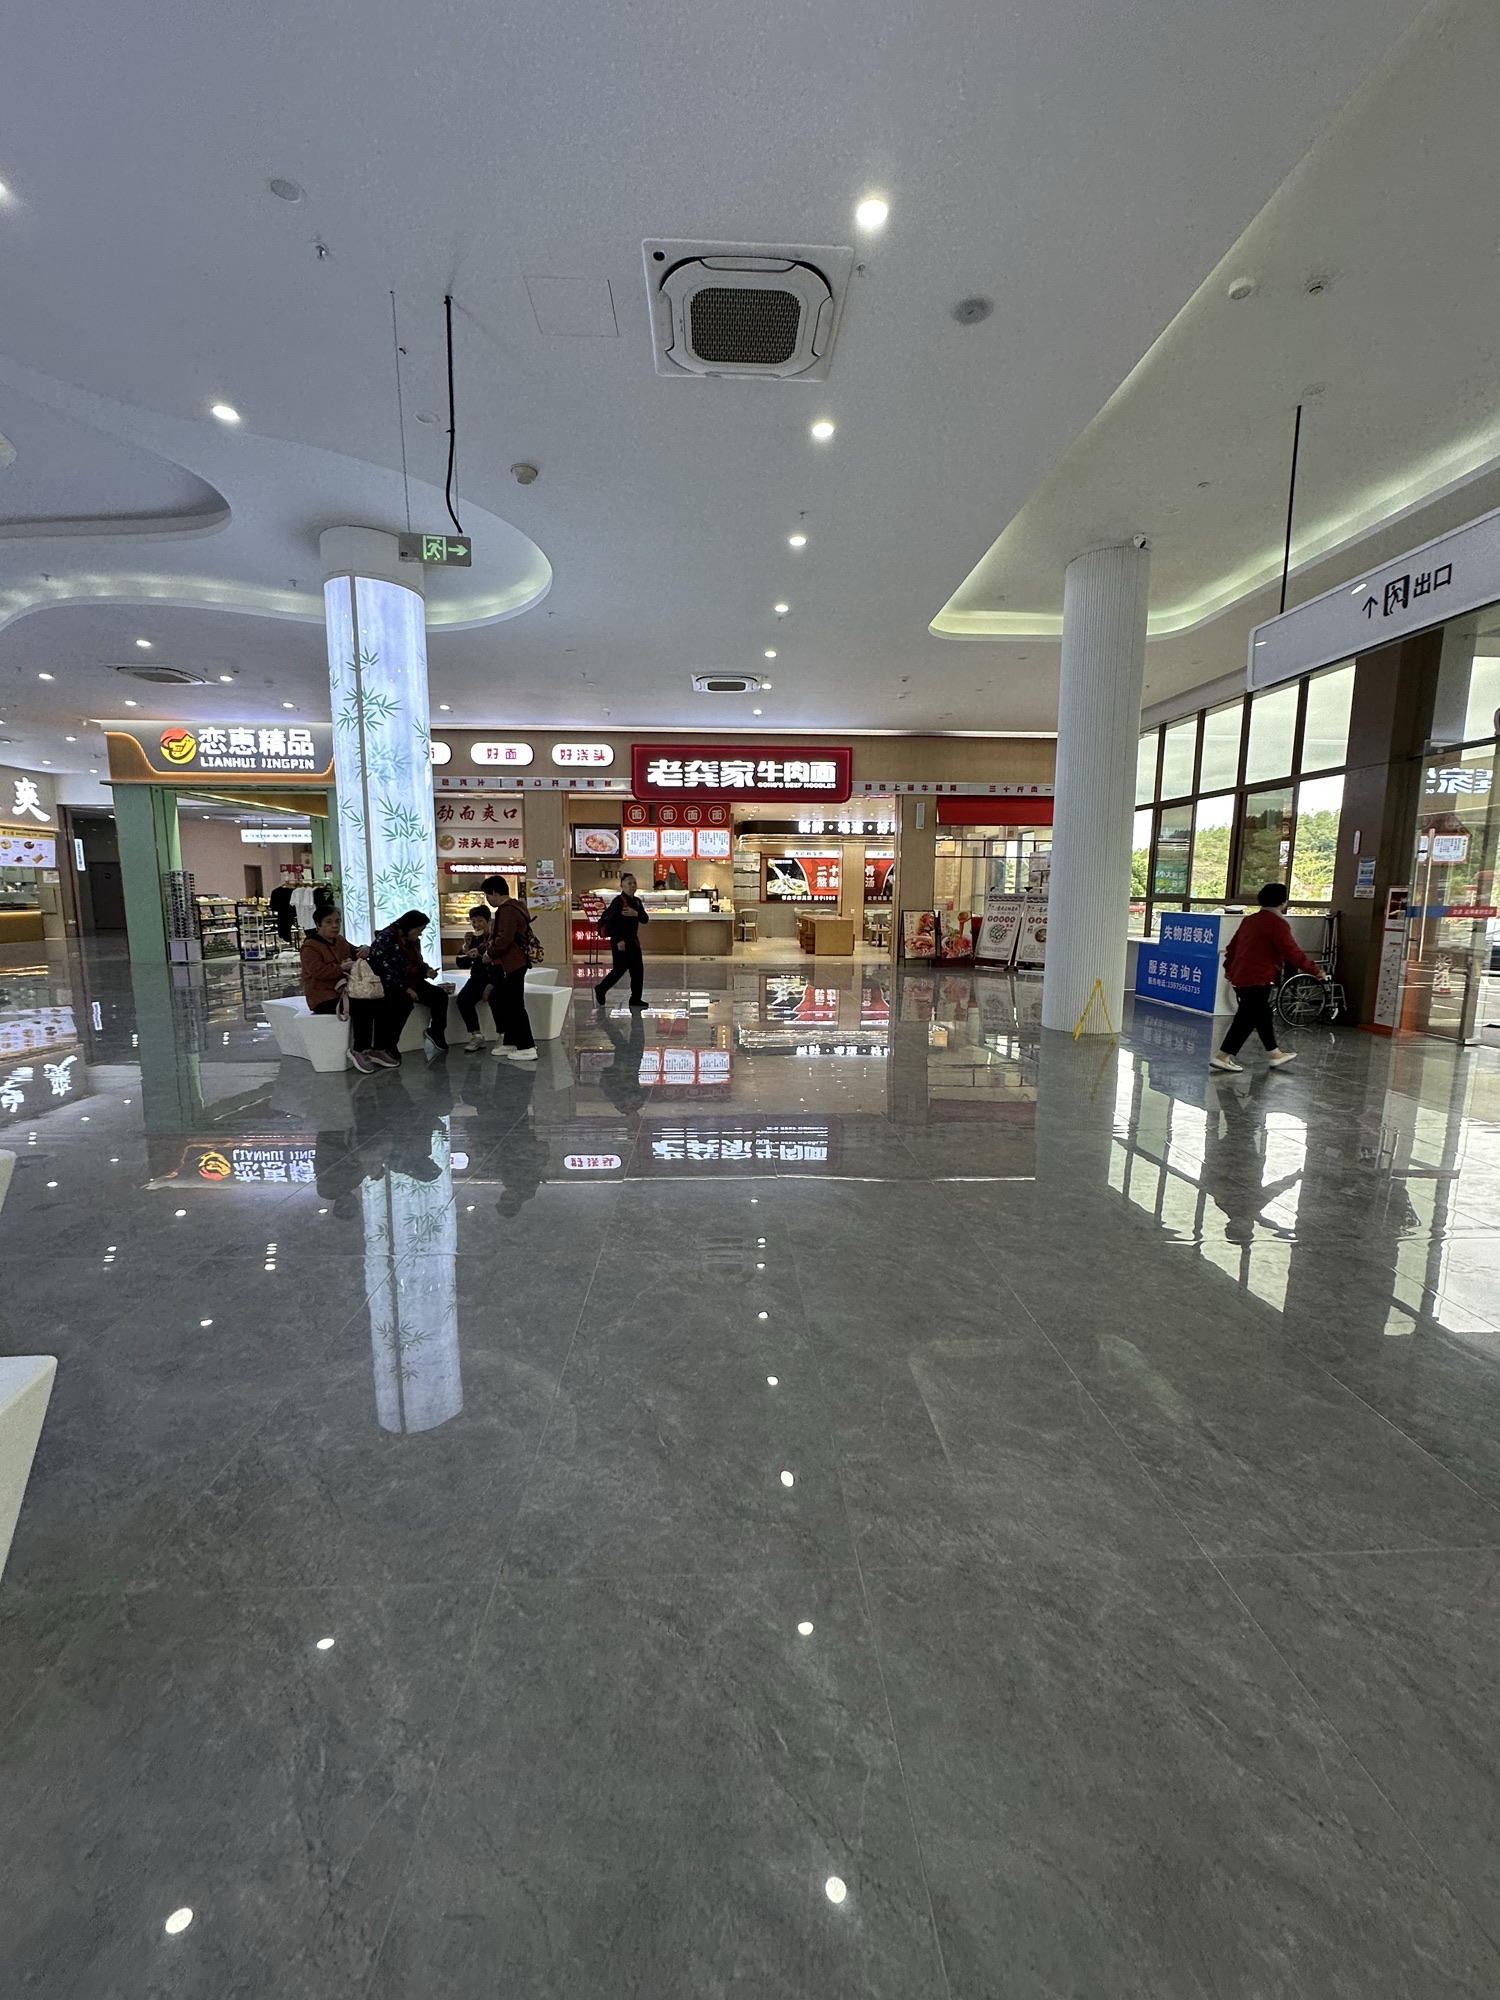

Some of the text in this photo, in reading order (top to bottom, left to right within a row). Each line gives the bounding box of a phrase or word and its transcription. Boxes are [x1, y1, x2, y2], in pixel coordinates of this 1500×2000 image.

[1413, 562, 1453, 599] 出口
[200, 756, 315, 770] LIANHUI JINGPIN
[487, 748, 517, 760] 好面
[437, 803, 518, 823] 劲面爽口
[458, 837, 520, 849] 浇头是一绝
[1163, 925, 1214, 945] 失物招领处
[1147, 959, 1202, 984] 服务咨询台
